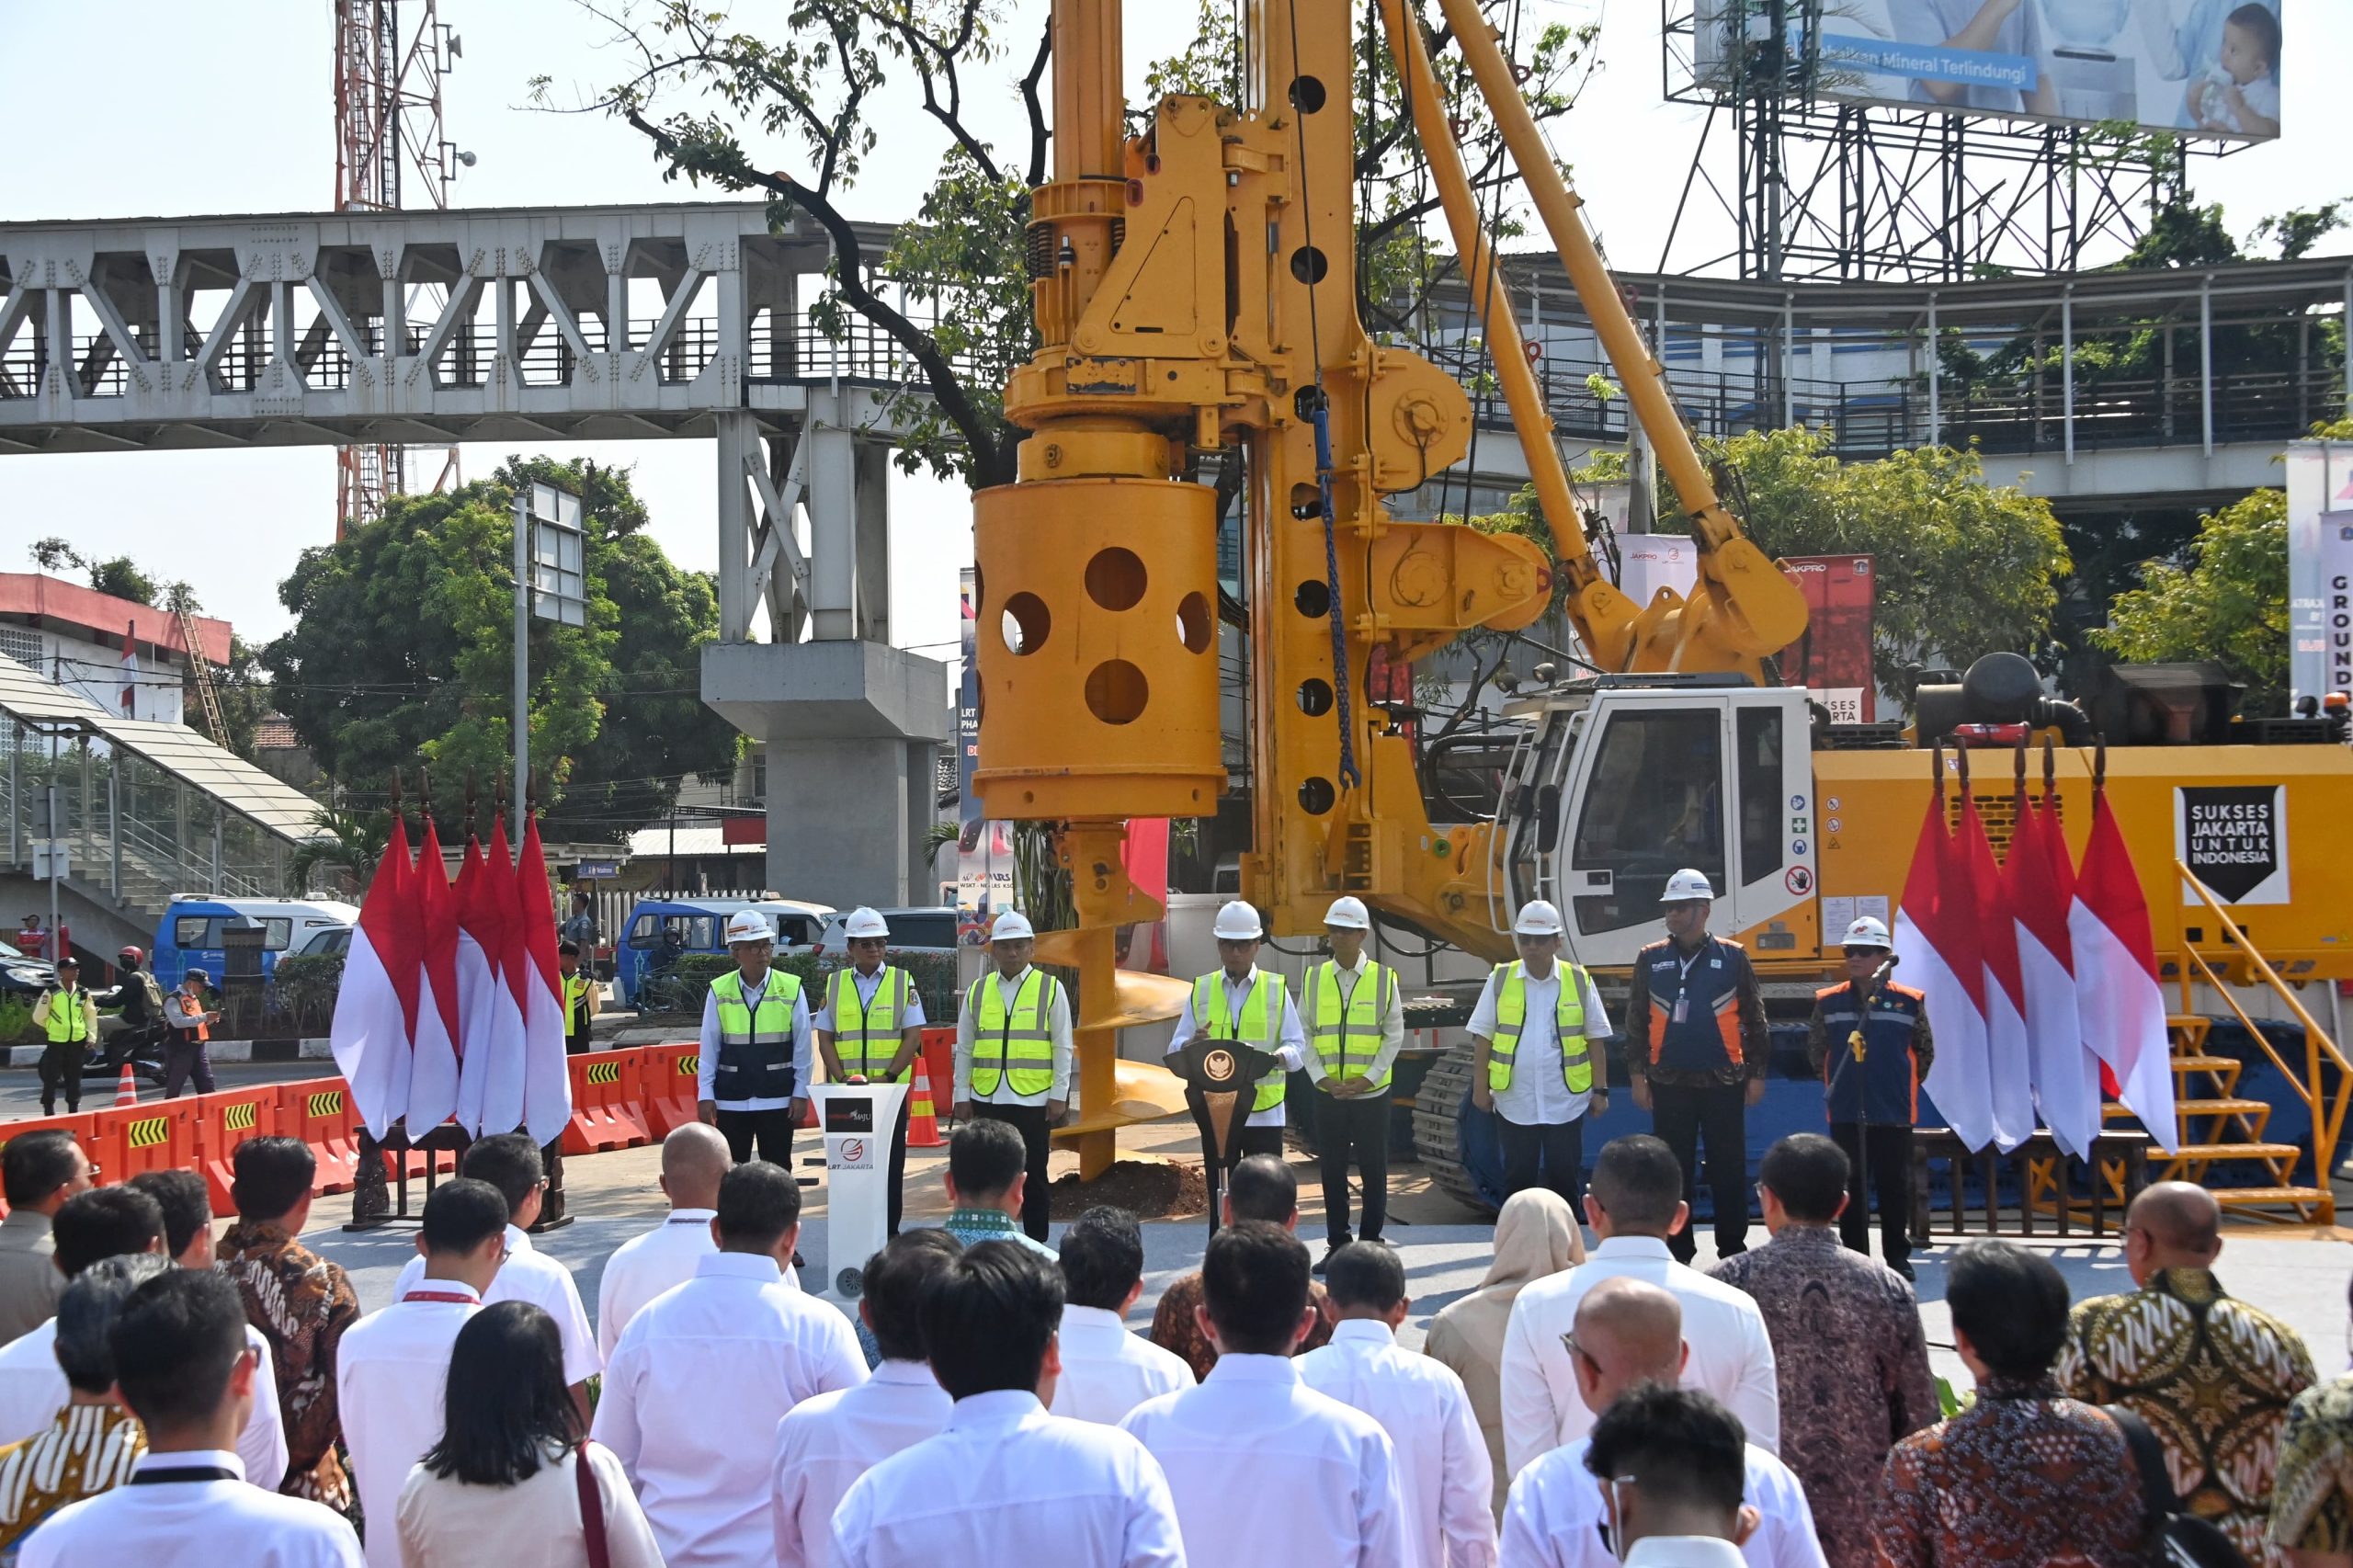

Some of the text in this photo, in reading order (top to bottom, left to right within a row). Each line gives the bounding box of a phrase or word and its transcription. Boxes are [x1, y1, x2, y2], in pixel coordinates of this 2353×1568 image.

[1882, 51, 1938, 73] Mineral
[1940, 58, 2027, 84] Terlindungi
[961, 708, 976, 718] LRT
[2191, 804, 2269, 820] SUKSES
[2191, 821, 2269, 837] JAKARTA
[2191, 837, 2269, 851] UNTUK
[2192, 851, 2270, 864] INDONESIA
[853, 1113, 871, 1122] MAJU
